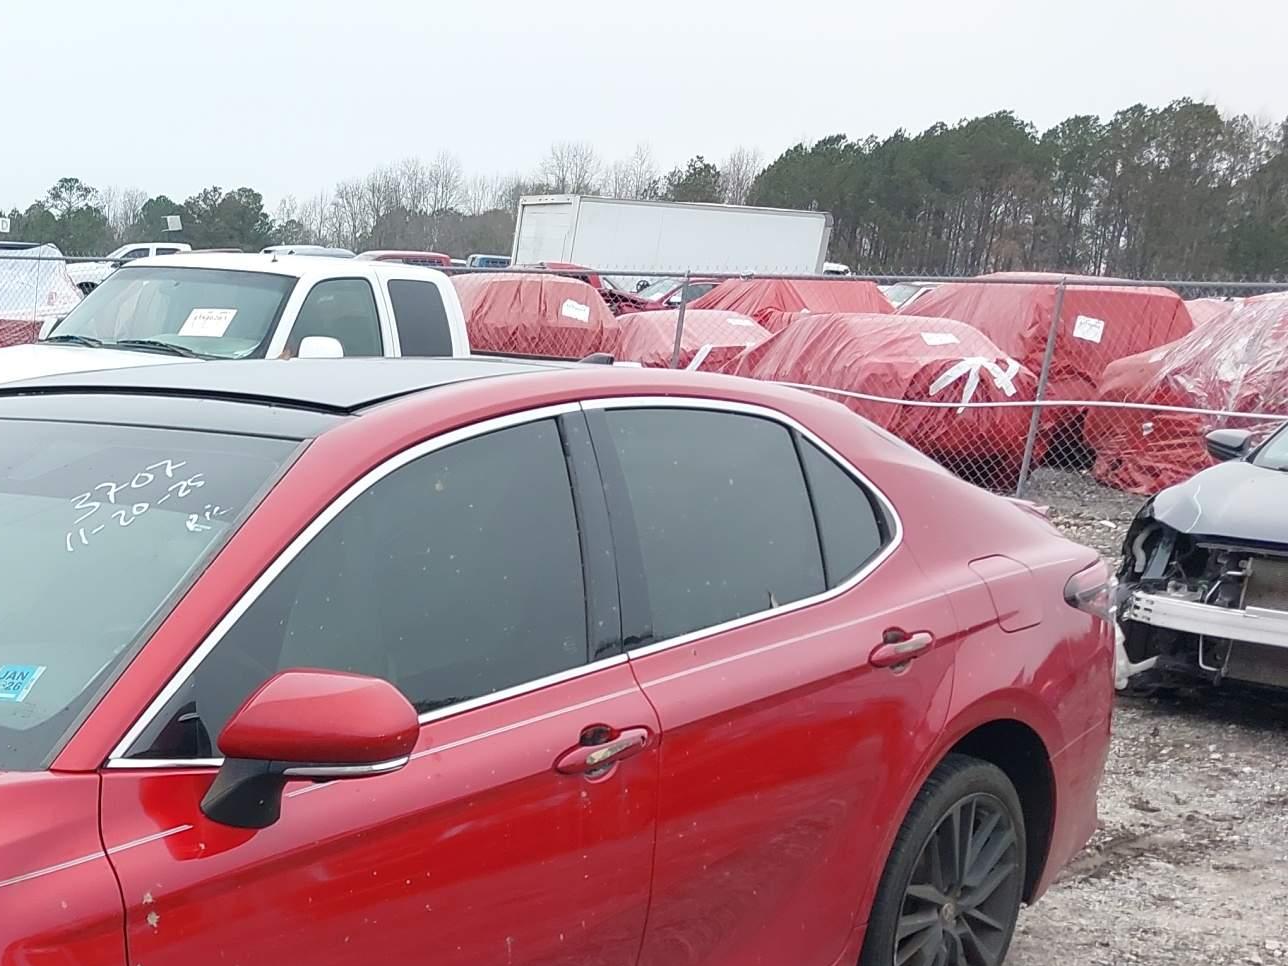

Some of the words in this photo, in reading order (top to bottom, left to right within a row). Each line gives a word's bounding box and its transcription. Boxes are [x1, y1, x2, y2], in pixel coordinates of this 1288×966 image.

[1, 219, 9, 231] D
[69, 459, 187, 524] 3707
[0, 670, 30, 681] JAN
